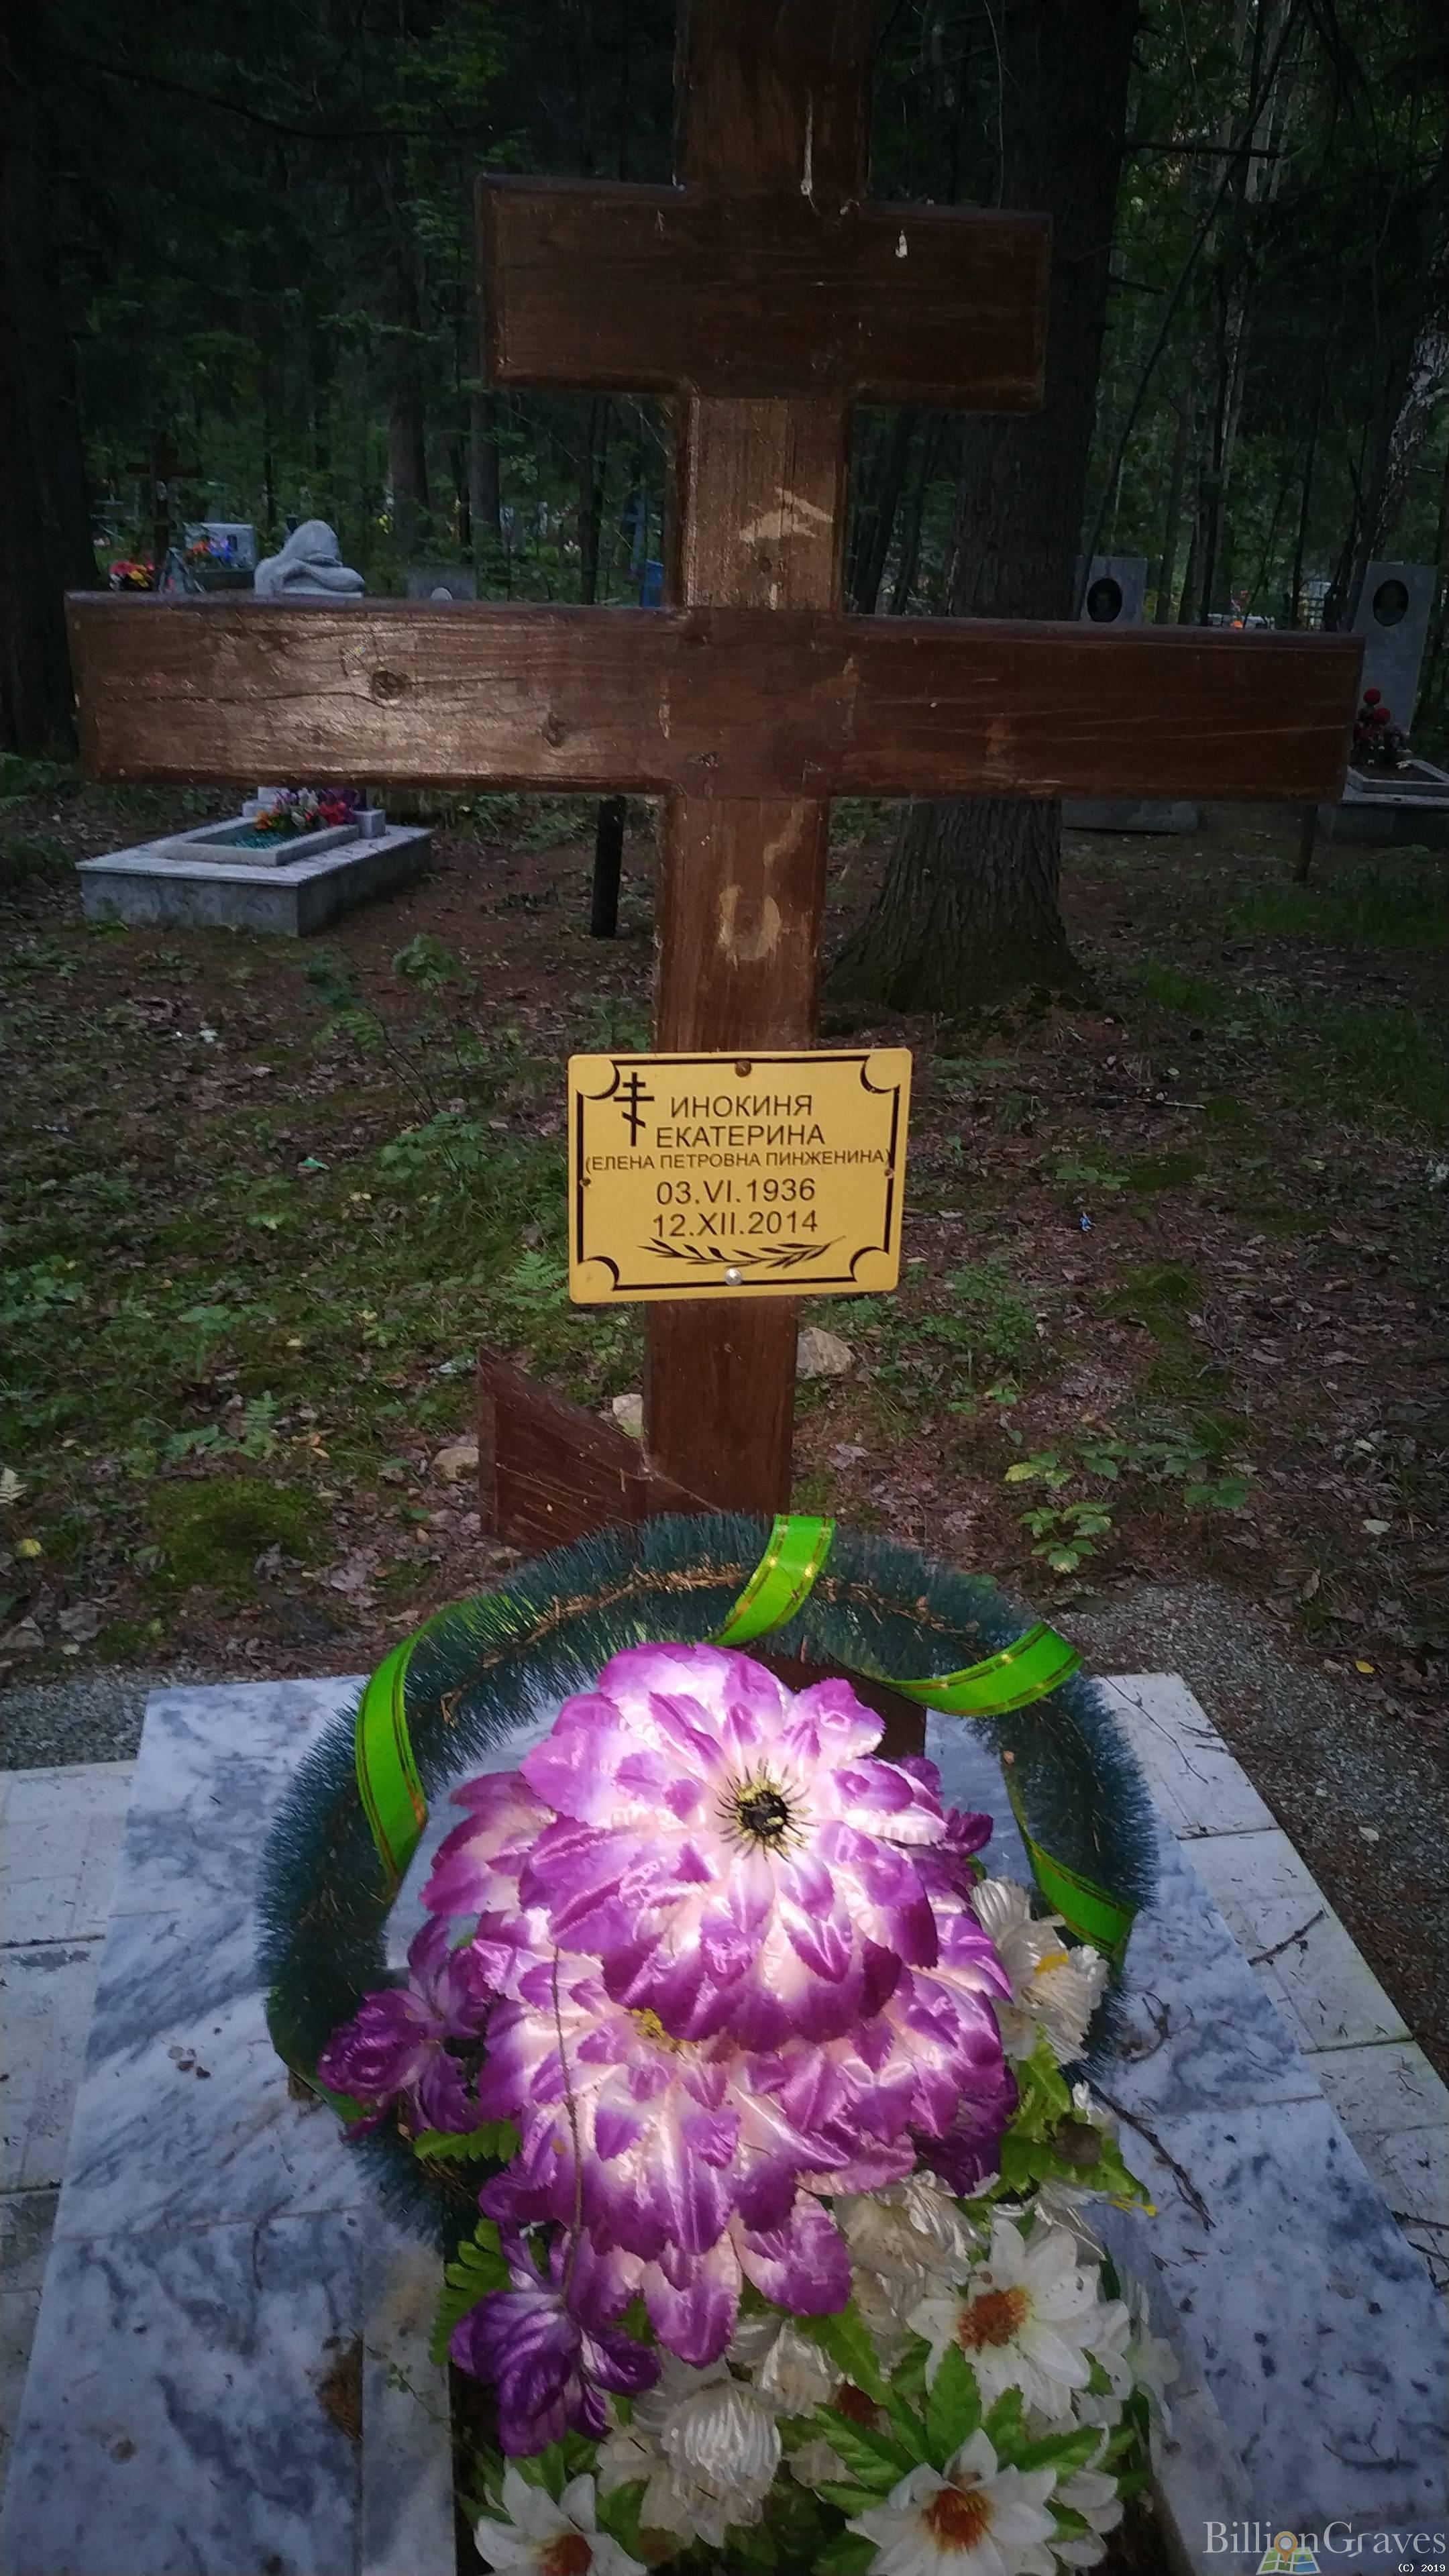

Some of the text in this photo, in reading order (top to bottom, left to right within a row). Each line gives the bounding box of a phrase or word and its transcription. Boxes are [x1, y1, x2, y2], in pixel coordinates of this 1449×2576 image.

[670, 1094, 813, 1118] ИНОКИНЯ
[656, 1124, 825, 1148] ЕКАТЕРИНА
[585, 1148, 892, 1175] (ЕЛЕНА ПЕТРОВНА ПИНЖЕНИНА)
[656, 1177, 816, 1205] 03.VI.1936
[652, 1210, 818, 1238] 12.XII.2014
